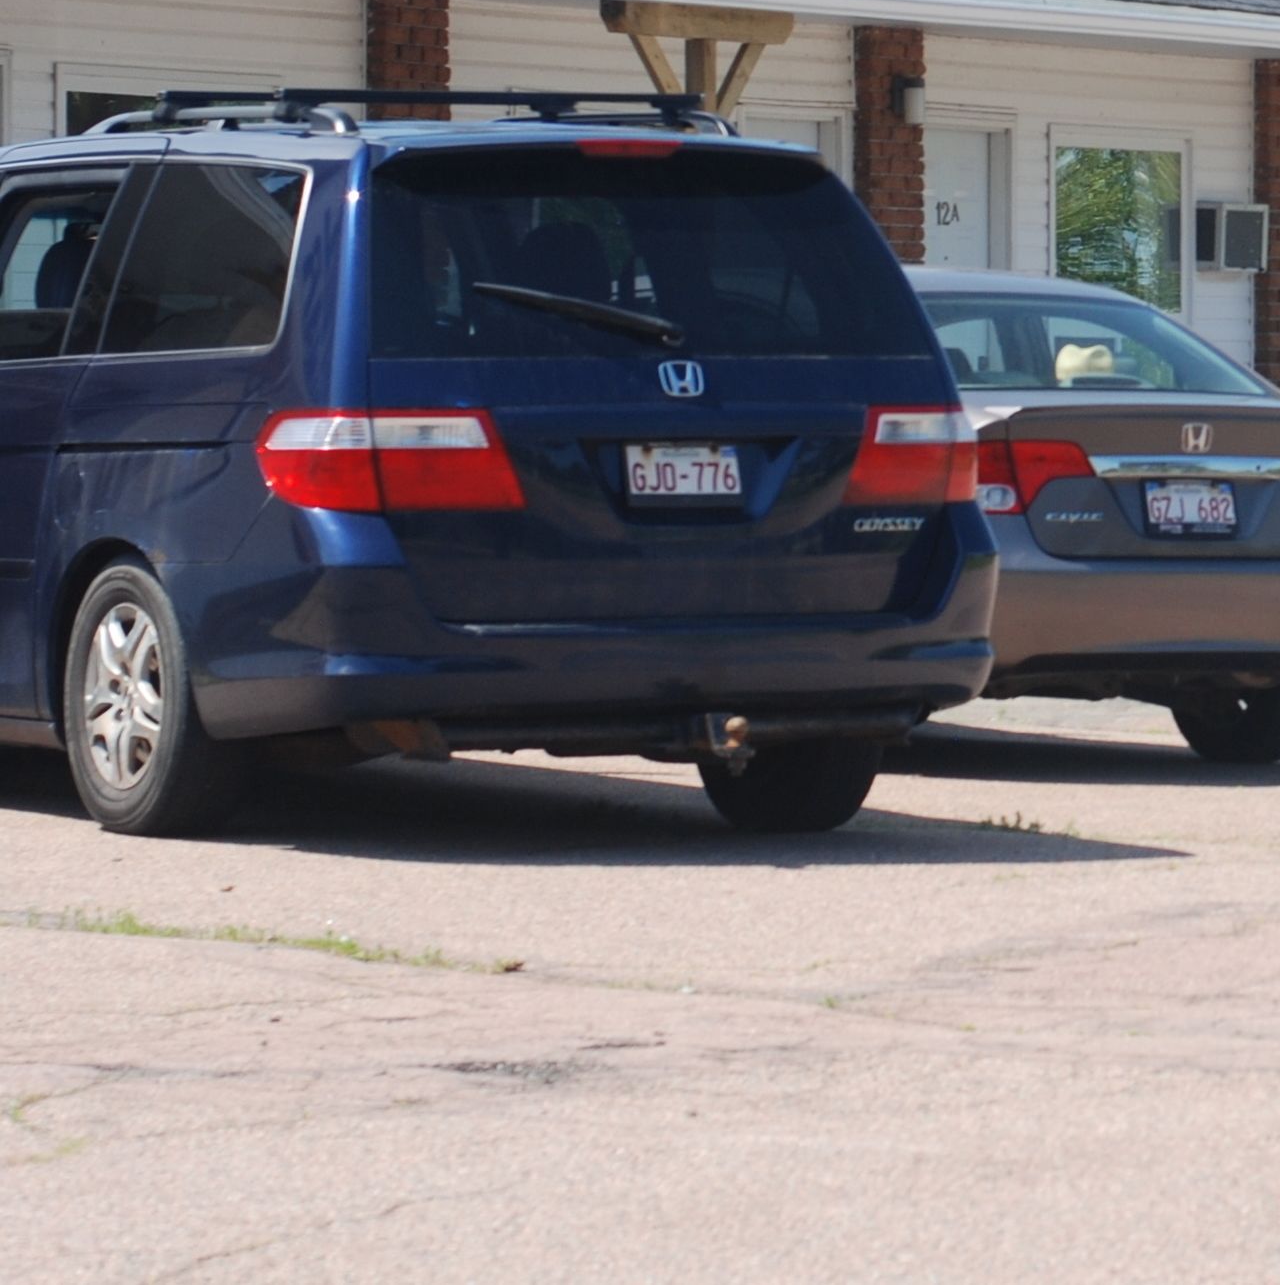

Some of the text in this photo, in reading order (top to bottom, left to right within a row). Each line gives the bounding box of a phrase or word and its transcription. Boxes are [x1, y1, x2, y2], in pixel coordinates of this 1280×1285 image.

[935, 200, 960, 226] 12A
[1150, 496, 1233, 523] GZJ 682
